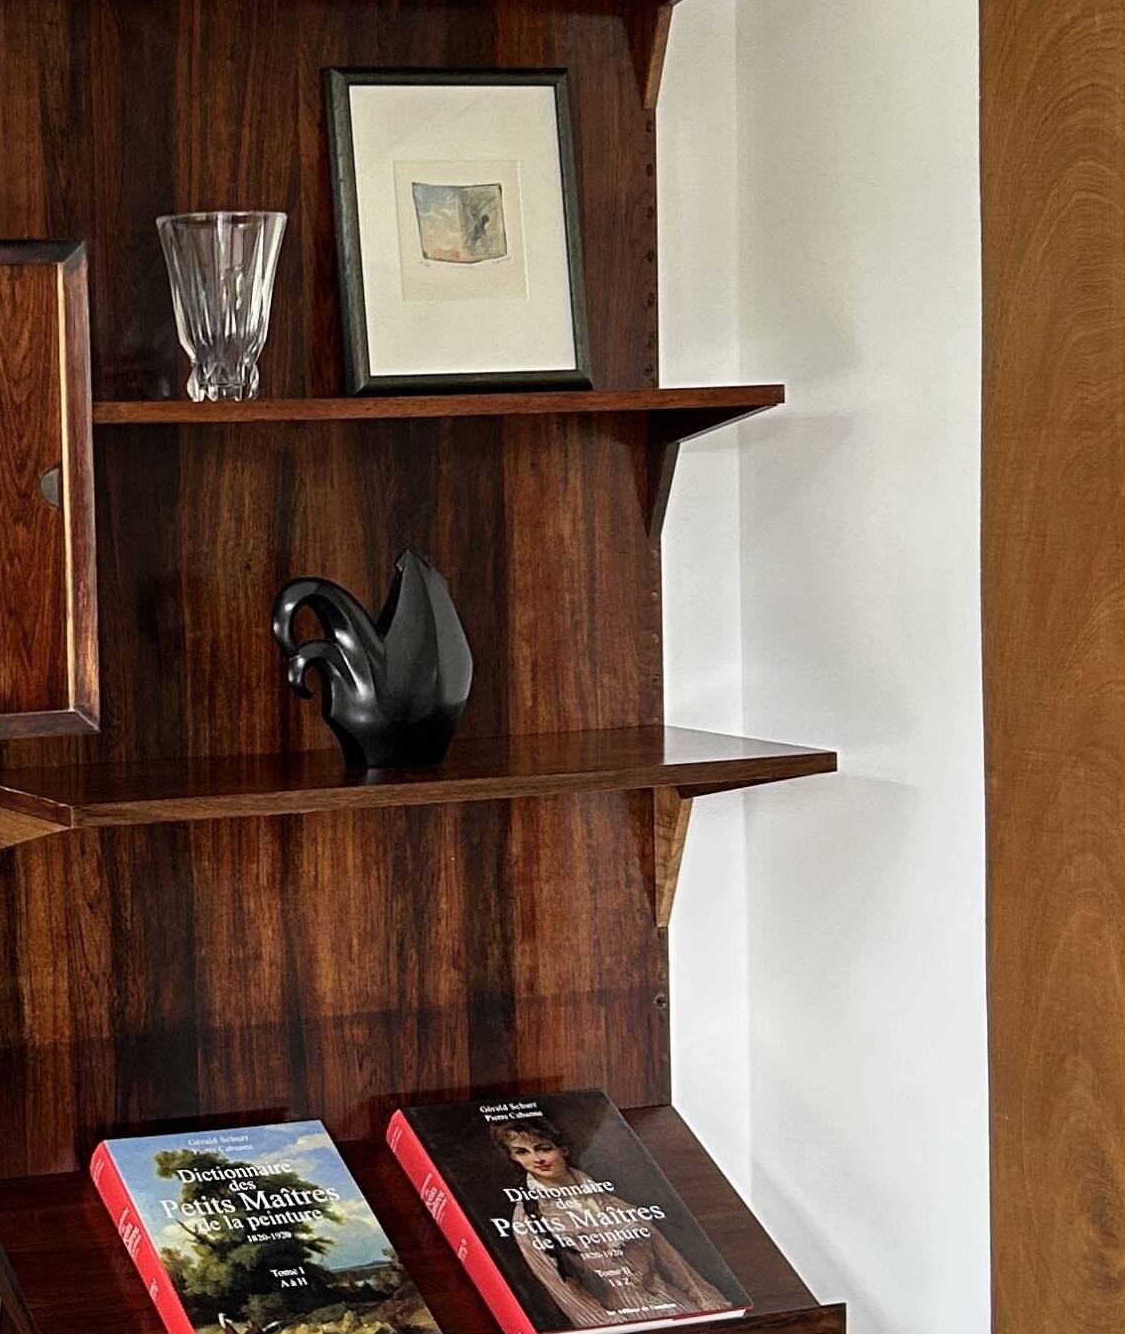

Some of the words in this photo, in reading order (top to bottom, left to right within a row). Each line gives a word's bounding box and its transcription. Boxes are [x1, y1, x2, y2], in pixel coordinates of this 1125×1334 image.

[177, 1162, 292, 1184] Dictionnaire
[229, 1178, 257, 1192] des
[159, 1195, 236, 1218] Petits
[238, 1186, 341, 1213] Maîtres
[503, 1179, 615, 1203] Dictionnaire
[556, 1197, 582, 1210] des
[197, 1217, 221, 1235] de
[223, 1214, 245, 1230] la
[246, 1207, 324, 1231] peinture
[489, 1214, 566, 1238] Petits
[566, 1204, 666, 1230] Maîtres
[531, 1235, 555, 1251] de
[555, 1233, 576, 1249] la
[578, 1225, 651, 1249] peinture
[270, 1268, 299, 1278] Tome
